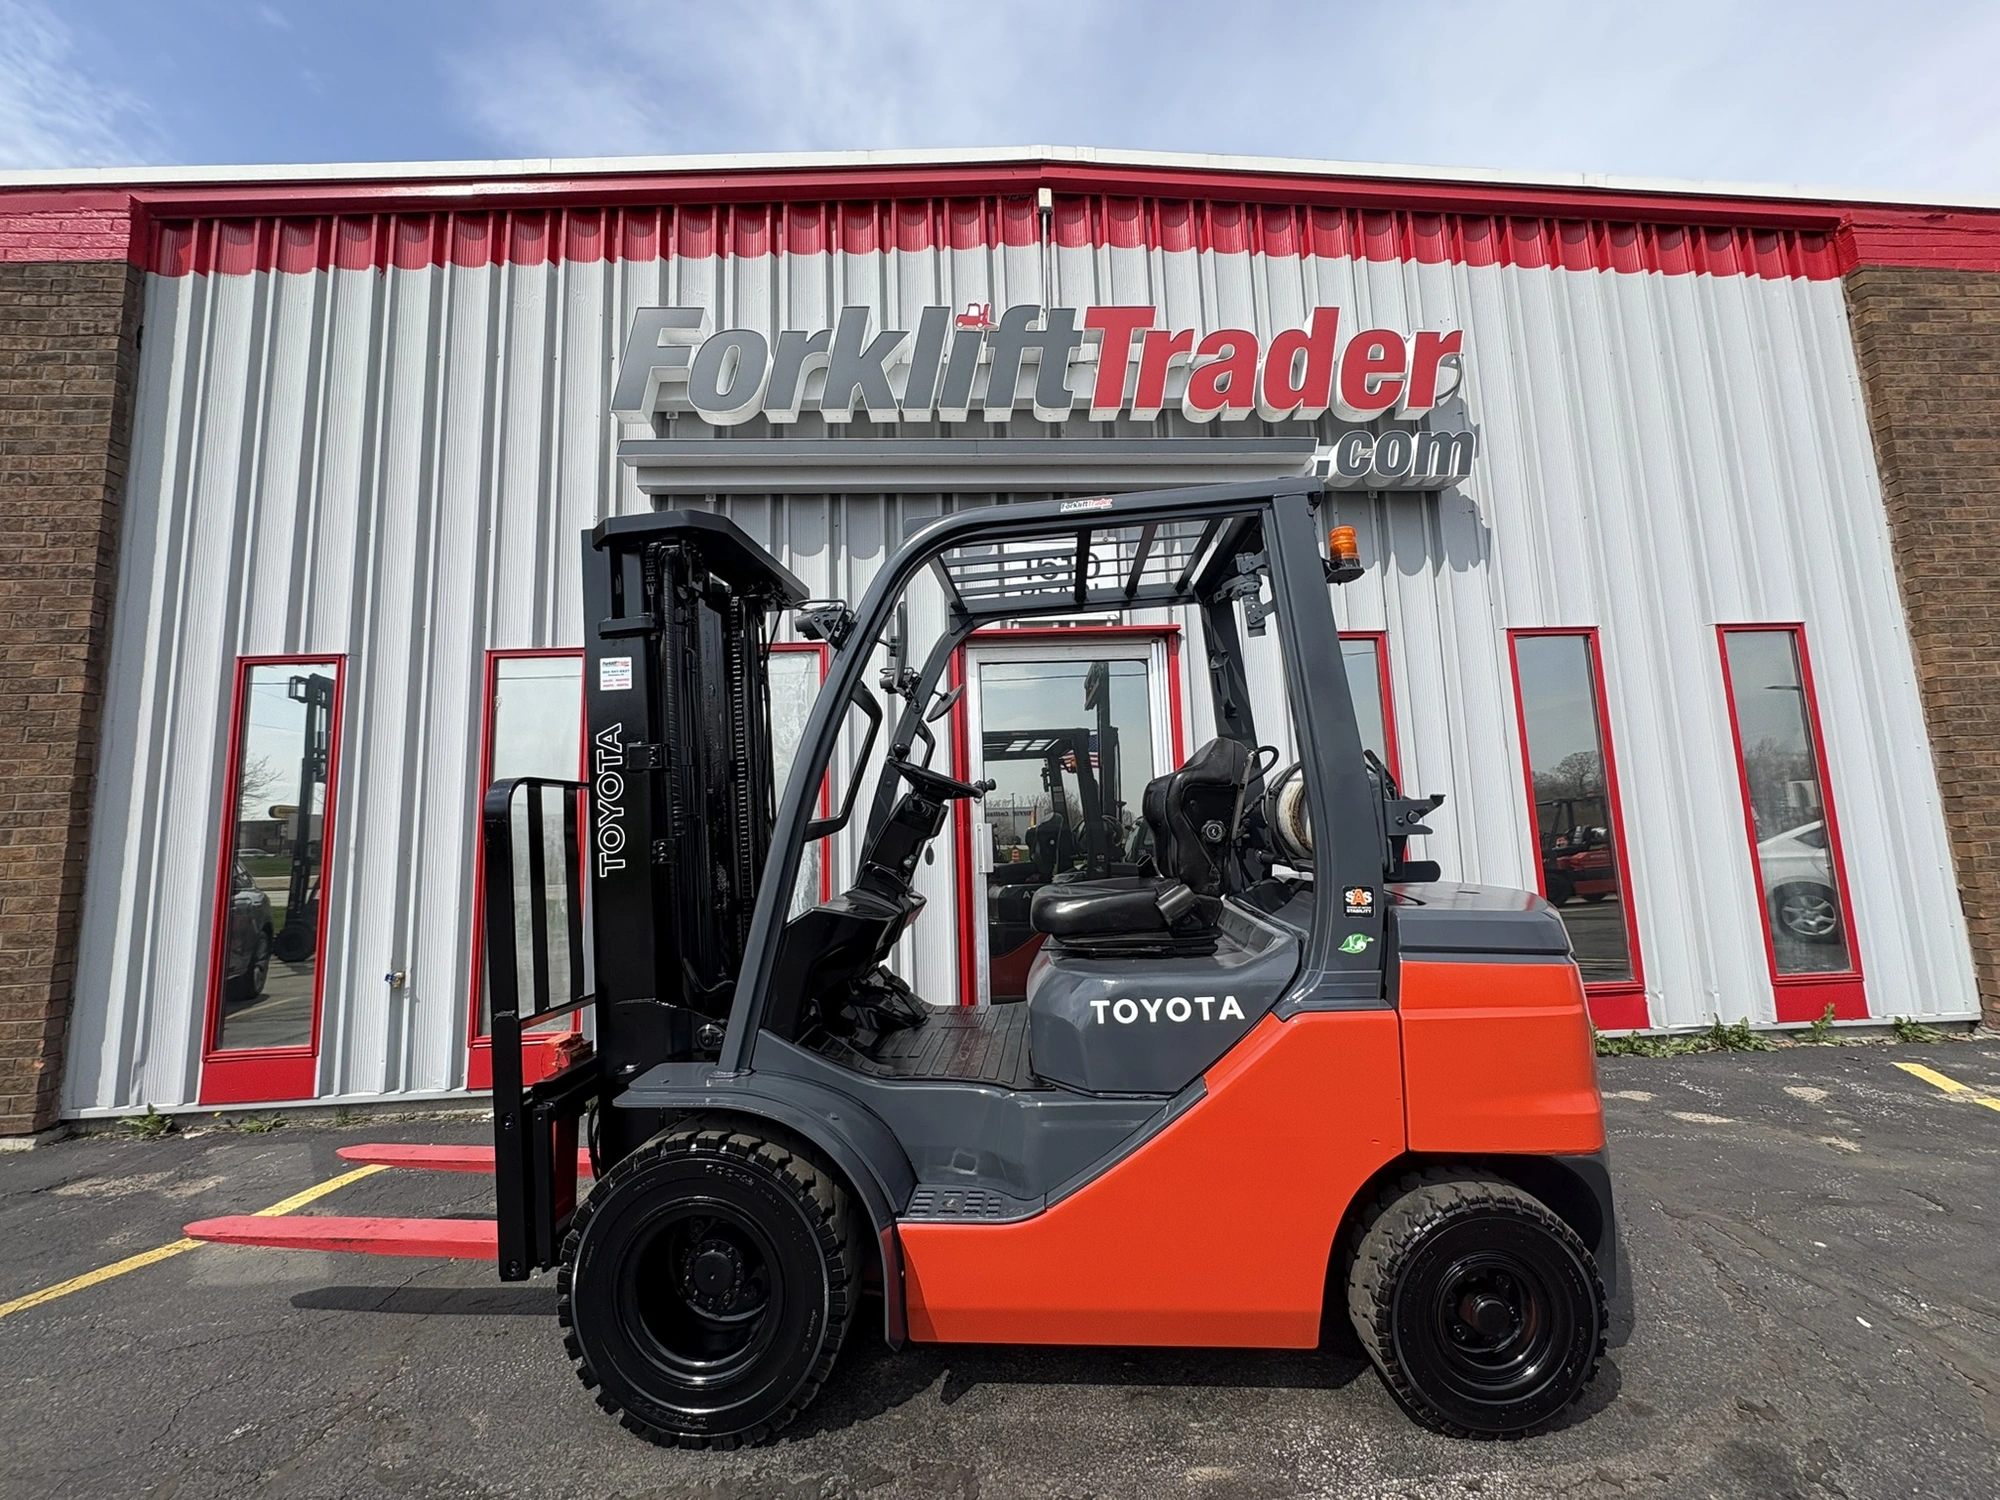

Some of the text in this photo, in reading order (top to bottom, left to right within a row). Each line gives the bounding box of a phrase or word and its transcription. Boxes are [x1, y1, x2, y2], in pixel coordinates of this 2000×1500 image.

[612, 304, 1463, 420] ForkliftTrader
[1314, 430, 1477, 480] .com
[596, 722, 626, 878] TOYOTA
[1345, 888, 1373, 905] SAS
[1089, 995, 1246, 1025] TOYOTA
